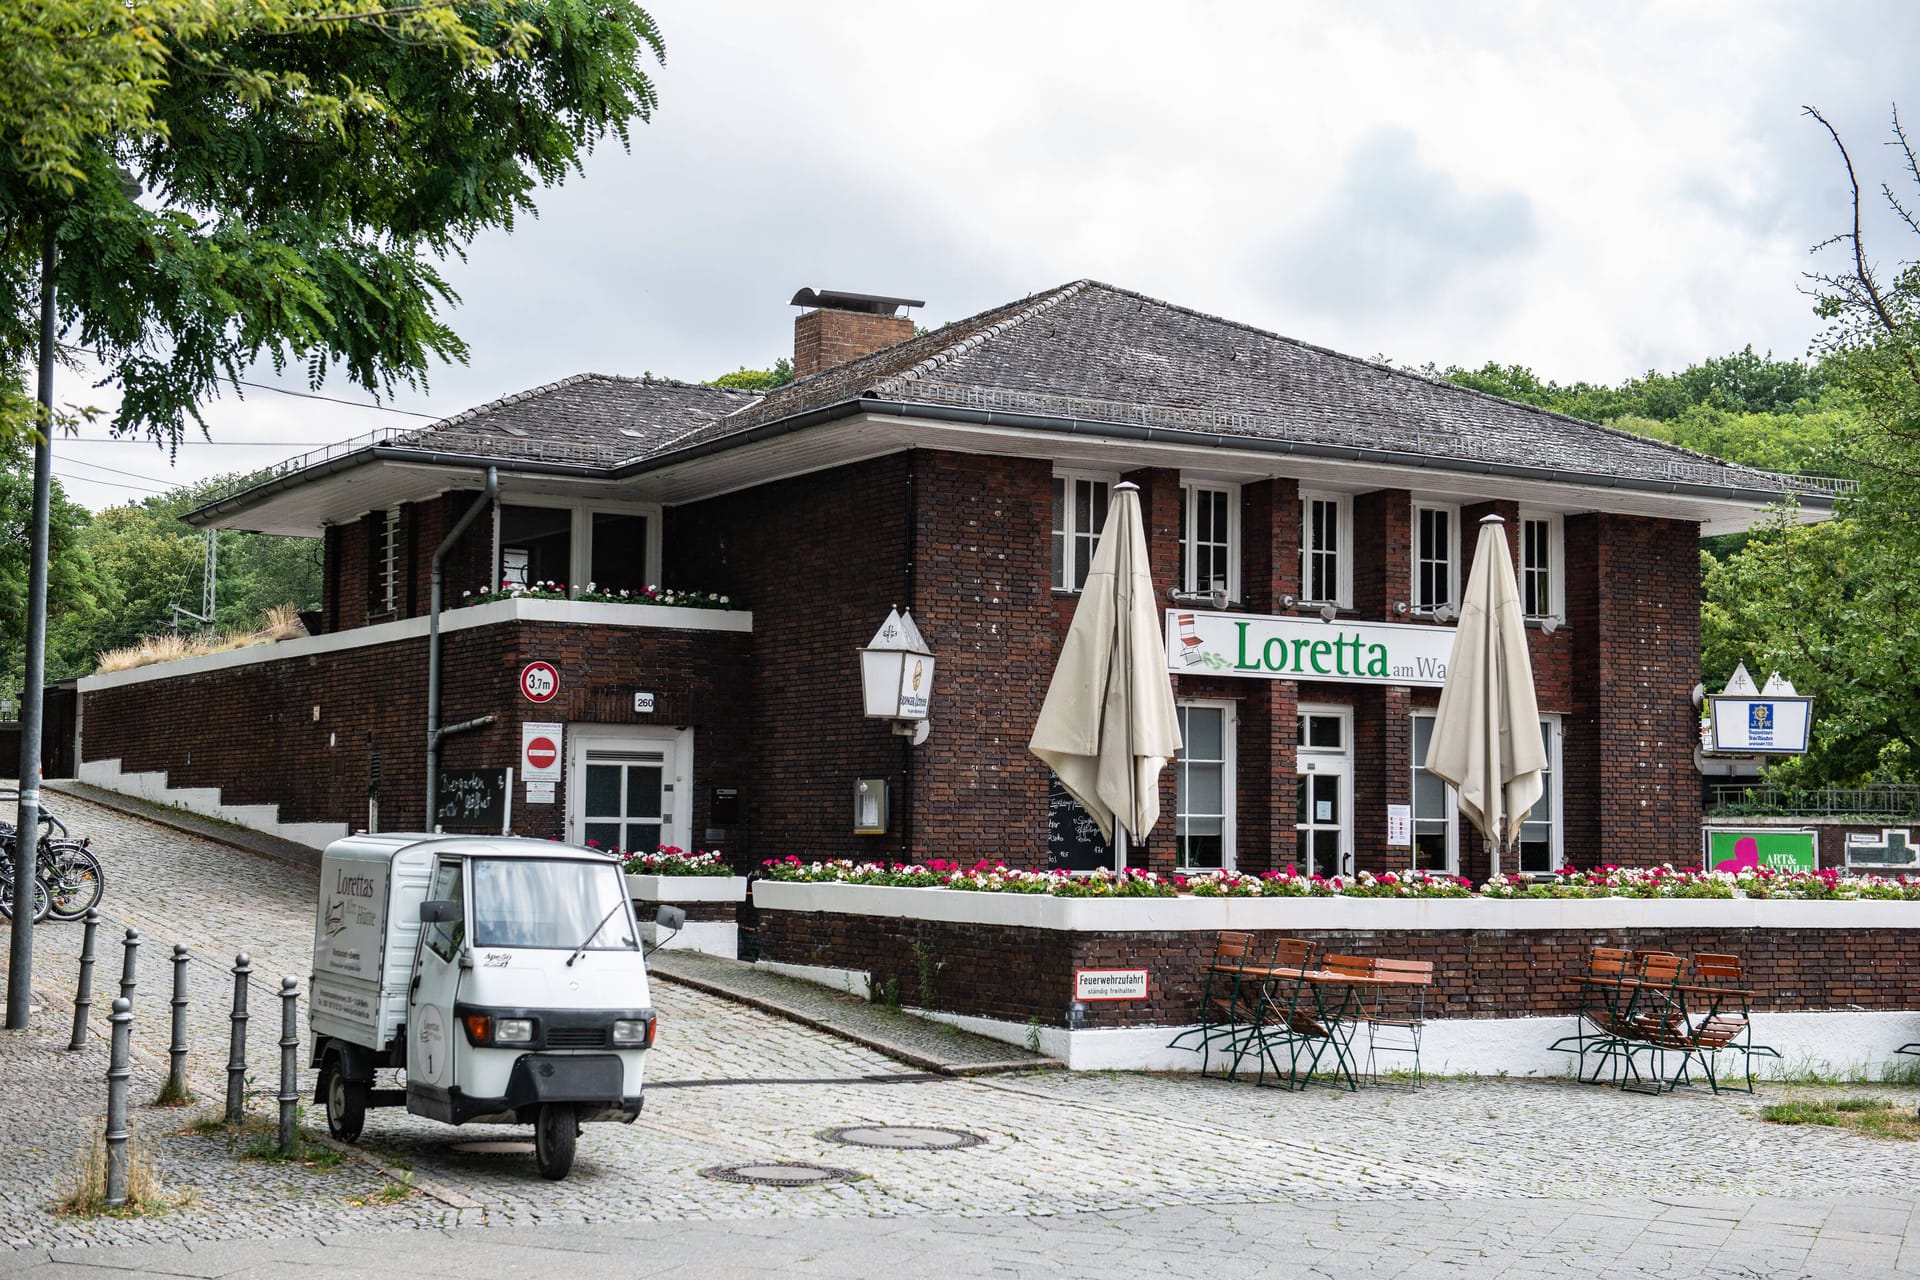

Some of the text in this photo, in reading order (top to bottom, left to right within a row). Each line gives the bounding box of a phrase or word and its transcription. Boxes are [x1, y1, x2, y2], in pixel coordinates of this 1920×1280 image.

[1234, 622, 1390, 677] Loretta
[1393, 665, 1414, 677] am
[638, 698, 654, 707] 260
[1766, 853, 1797, 865] ART&
[336, 868, 375, 898] Lorettas
[1080, 974, 1144, 985] Feuerwehrzufahrt
